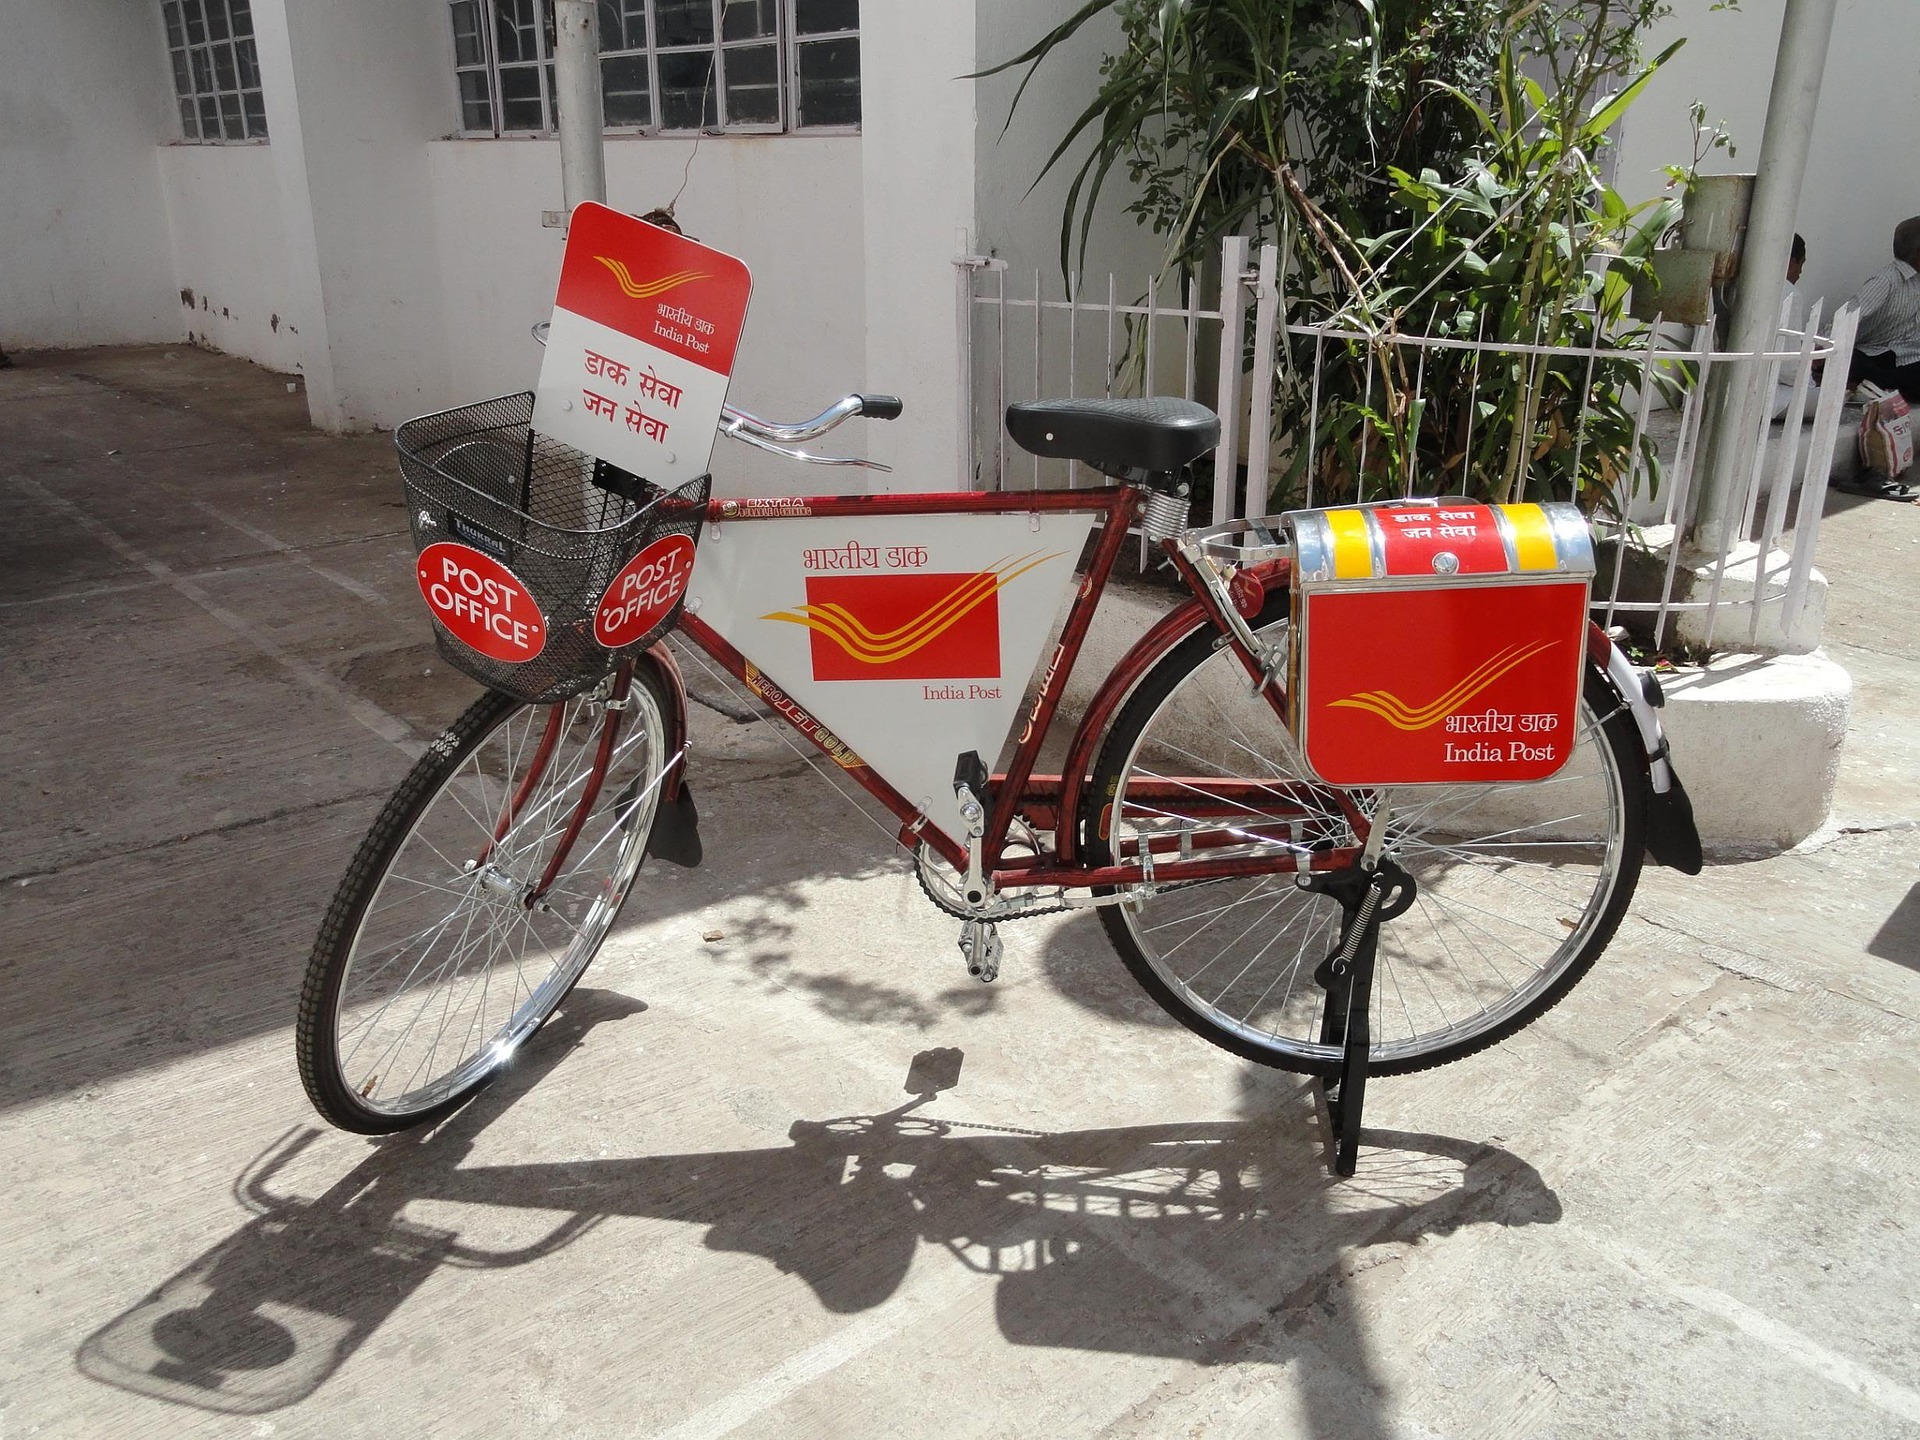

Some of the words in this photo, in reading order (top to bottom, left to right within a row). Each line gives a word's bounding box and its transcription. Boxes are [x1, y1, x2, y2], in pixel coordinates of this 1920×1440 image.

[657, 303, 693, 327] भारतीय
[694, 318, 715, 335] डाक
[653, 321, 683, 344] India
[685, 333, 710, 354] Post
[584, 349, 630, 386] डाक
[639, 365, 683, 409] सेवा
[582, 389, 618, 422] जन
[625, 400, 669, 444] सेवा
[746, 497, 805, 508] EXTRA
[780, 506, 812, 517] SHINING
[1391, 513, 1431, 523] डाक
[1436, 511, 1475, 521] सेवा
[1401, 527, 1432, 539] जन
[1436, 523, 1477, 539] सेवा
[803, 540, 880, 570] भारतीय
[885, 546, 928, 568] डाक
[442, 557, 518, 612] POST
[621, 547, 682, 600] POST
[430, 583, 529, 649] OFFICE
[604, 572, 682, 633] OFFICE
[923, 685, 964, 700] India
[968, 685, 1002, 700] Post
[751, 673, 782, 702] HERO
[814, 727, 858, 764] GOLD
[1445, 708, 1516, 733] भारतीय
[1518, 713, 1558, 732] डाक
[1443, 742, 1503, 762] India
[1507, 741, 1556, 761] Post
